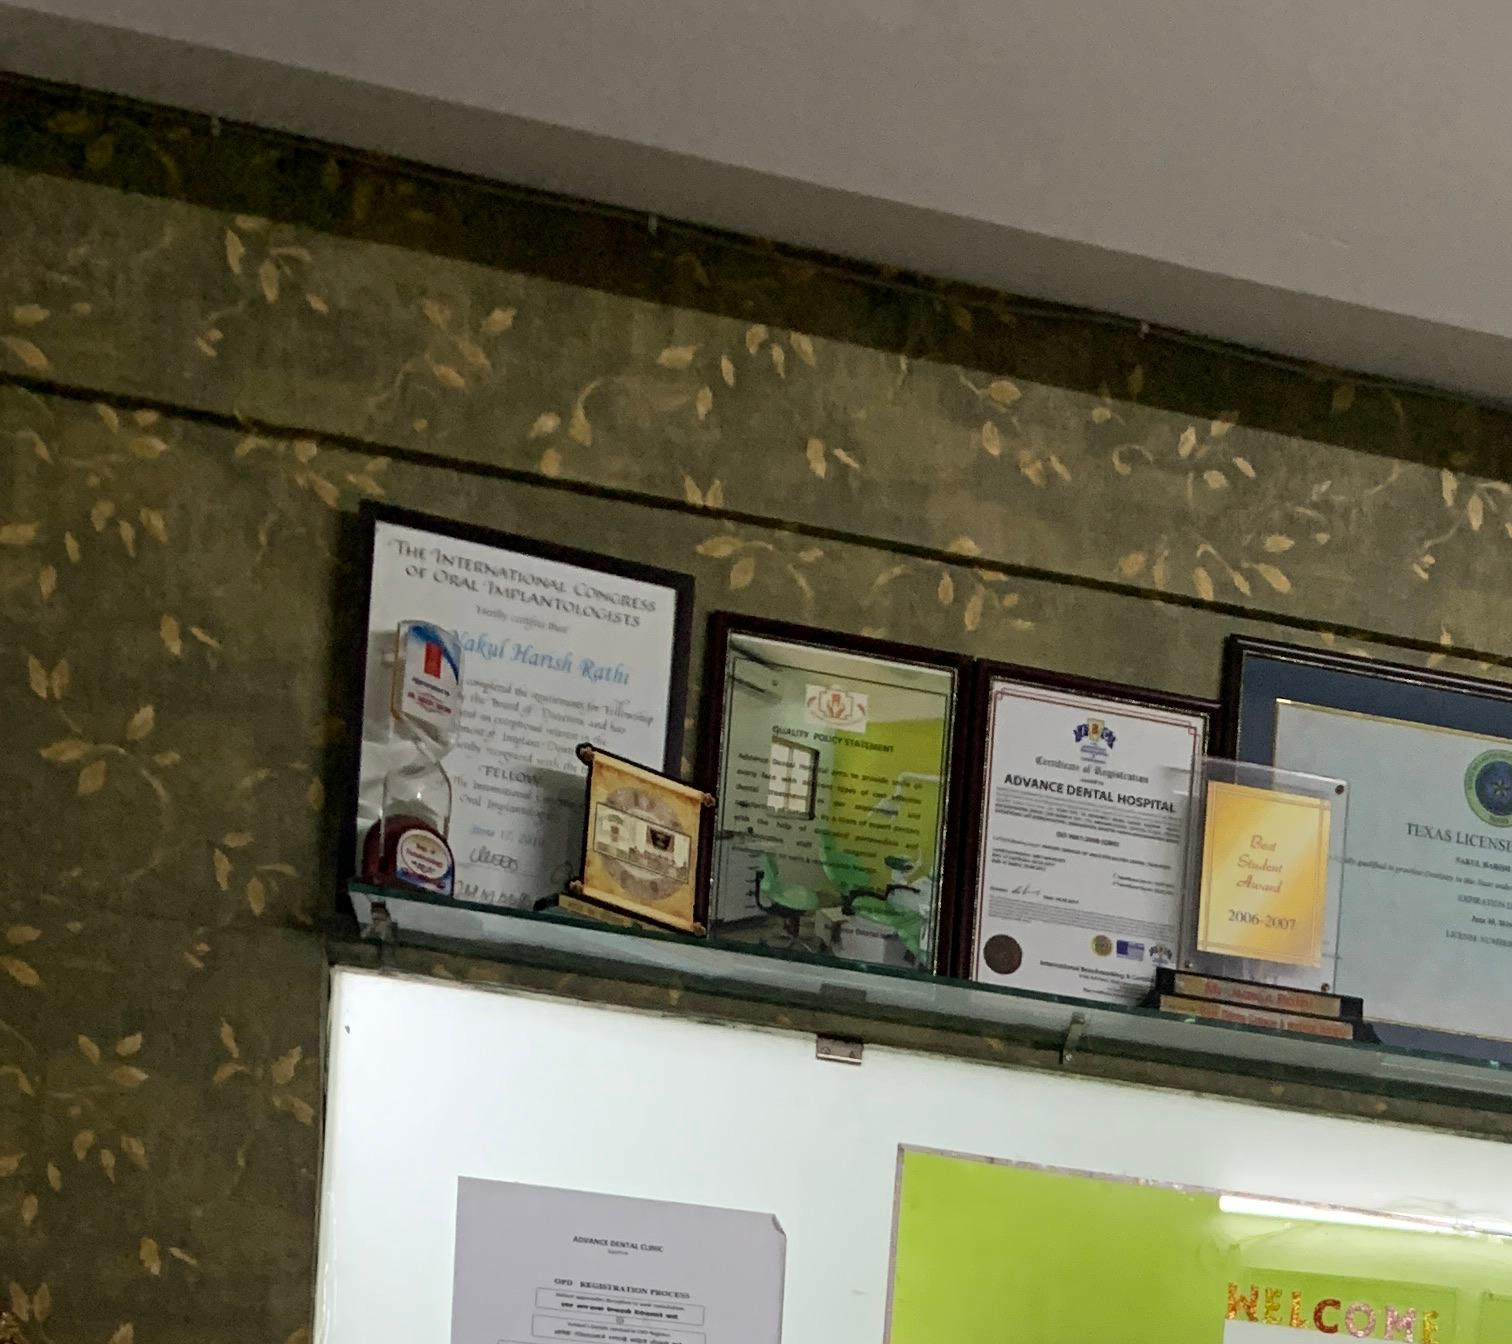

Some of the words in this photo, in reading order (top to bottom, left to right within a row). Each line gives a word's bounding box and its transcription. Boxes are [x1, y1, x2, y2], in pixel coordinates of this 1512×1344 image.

[390, 538, 426, 560] THE
[433, 546, 566, 593] INTERNATIONAL
[573, 582, 656, 613] CONGRESS
[405, 564, 427, 579] OF
[433, 570, 479, 593] ORAL
[484, 579, 641, 627] IMPLANTOLOGISTS
[512, 643, 573, 674] Harish
[579, 657, 629, 687] Rathi
[1004, 774, 1063, 794] ADVANCE
[1066, 784, 1113, 802] DENTAL
[1117, 793, 1176, 813] HOSPITAL
[1250, 834, 1277, 852] Best
[1405, 822, 1452, 843] TEXAS
[1237, 853, 1282, 872] Student
[1236, 874, 1282, 893] Award
[1228, 908, 1296, 929] 2006-2007
[573, 1235, 608, 1246] ADVANCE
[610, 1240, 638, 1250] DENTAL
